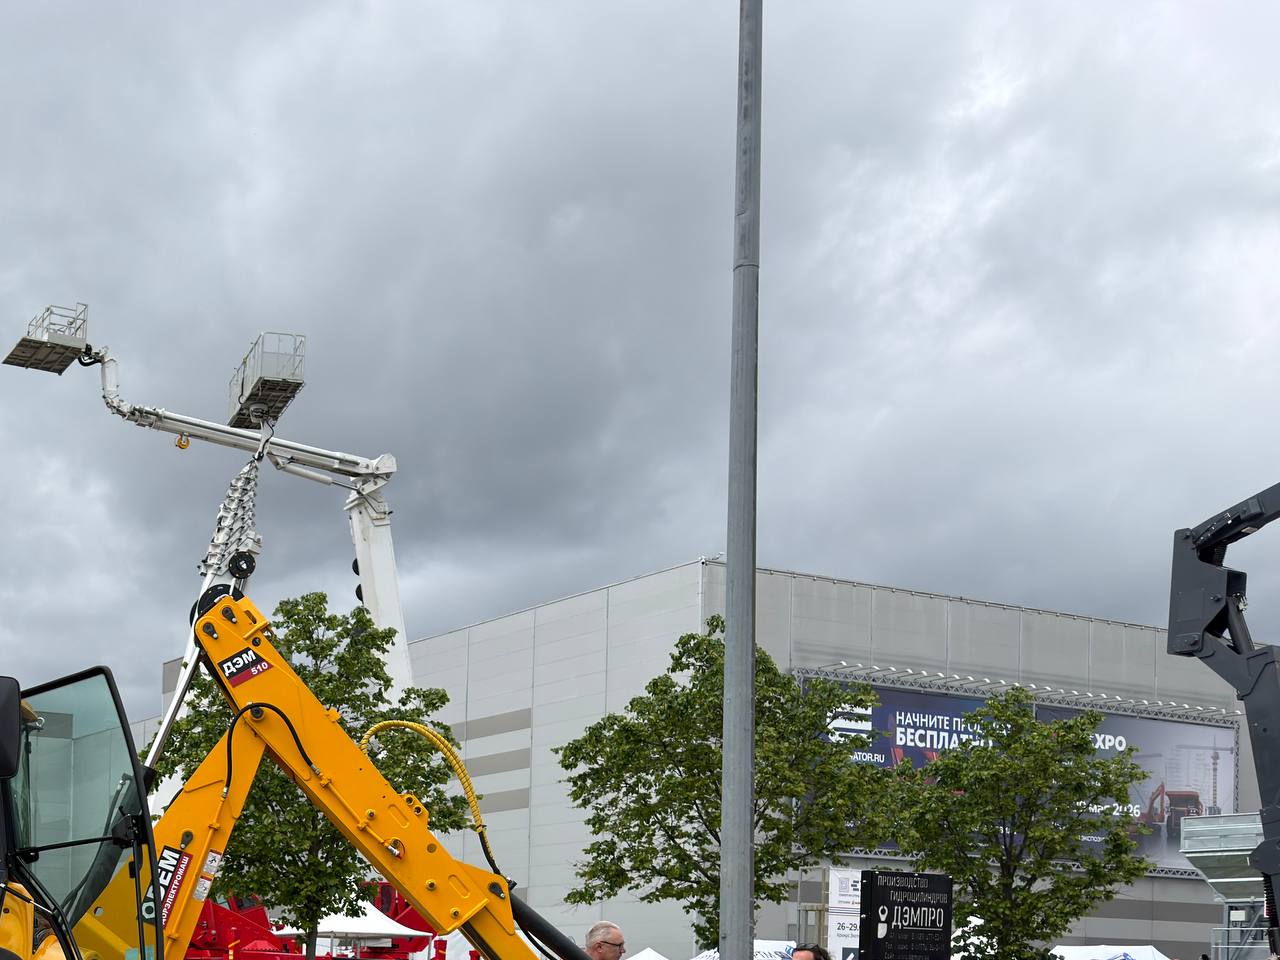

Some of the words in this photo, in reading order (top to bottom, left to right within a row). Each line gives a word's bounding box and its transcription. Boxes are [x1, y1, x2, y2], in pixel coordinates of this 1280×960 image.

[222, 649, 257, 677] ДЭМ
[250, 661, 269, 675] 510
[895, 711, 950, 730] НАЧНИТЕ
[850, 751, 885, 764] ATOR.RU
[877, 875, 929, 889] ПРОИЗВОДСТВО
[889, 890, 949, 904] ГИДРОЦИЛИНДРОВ
[891, 905, 945, 930] ДЭМПРО
[836, 922, 860, 931] 26-29.
